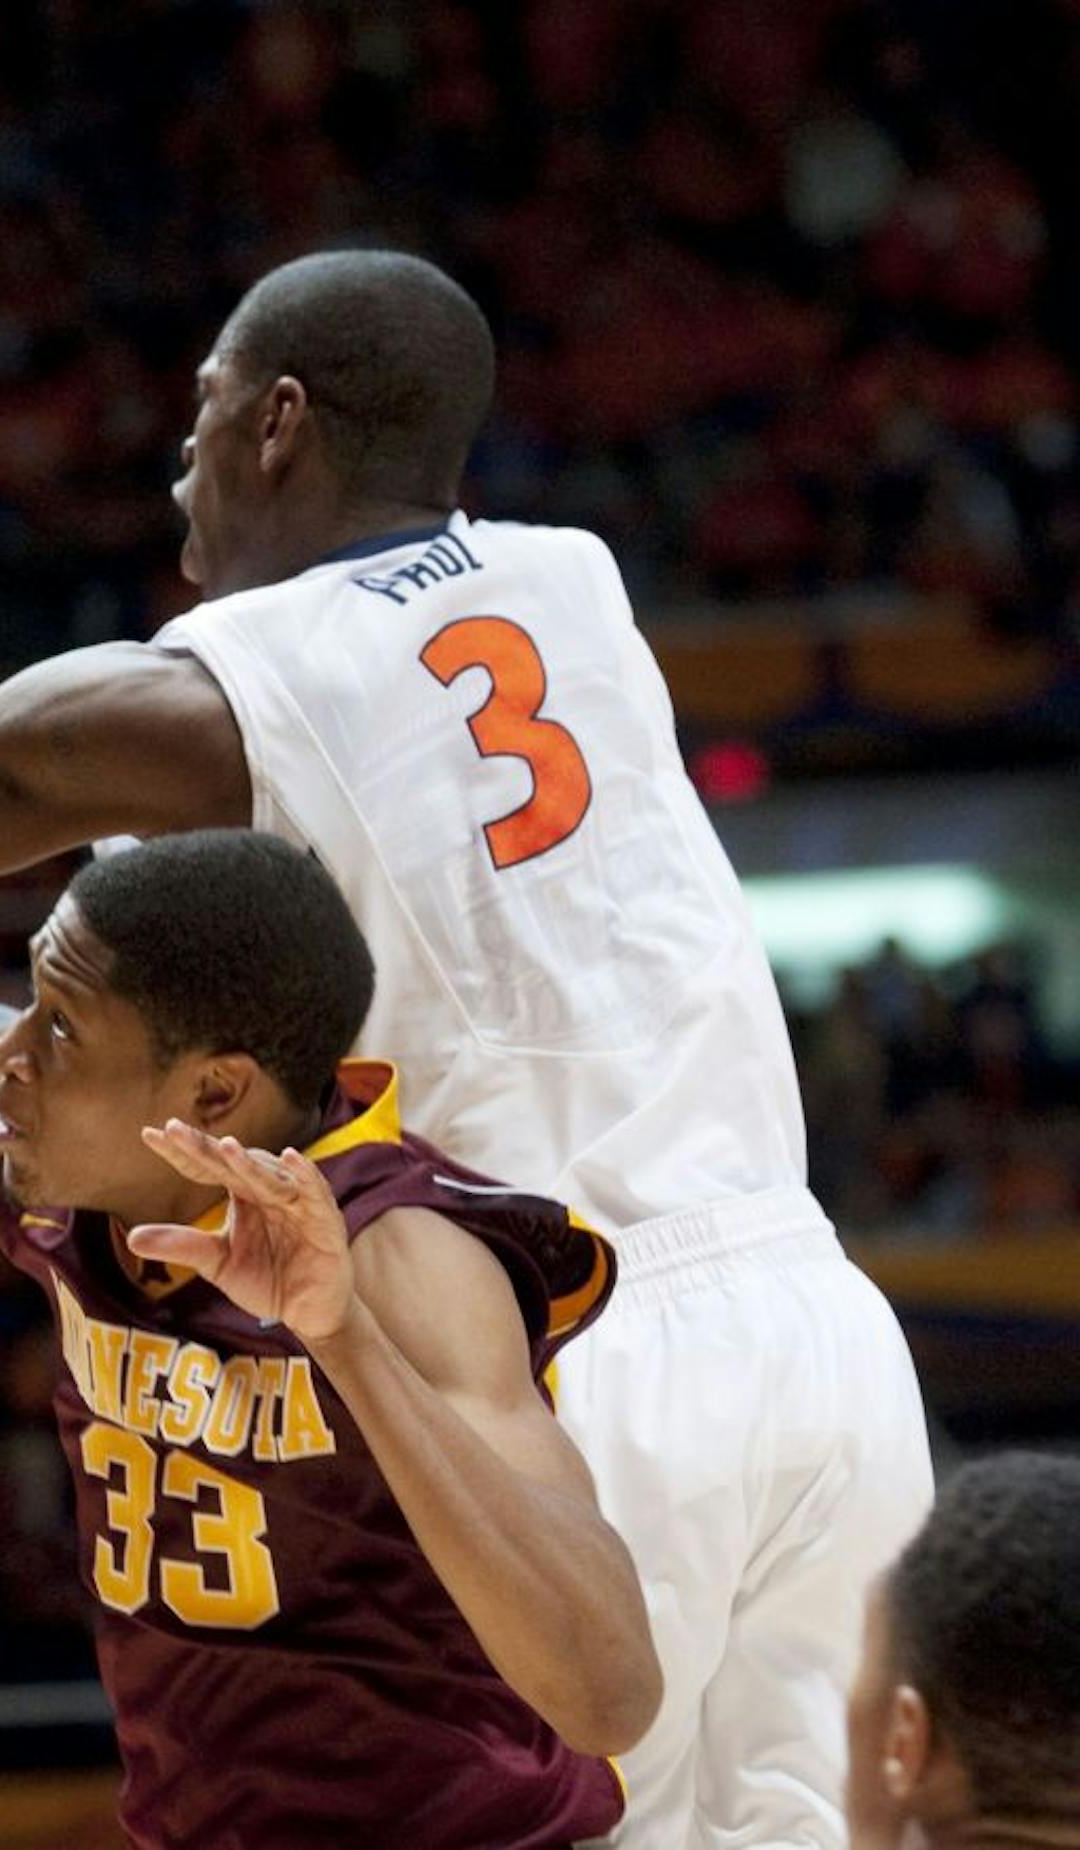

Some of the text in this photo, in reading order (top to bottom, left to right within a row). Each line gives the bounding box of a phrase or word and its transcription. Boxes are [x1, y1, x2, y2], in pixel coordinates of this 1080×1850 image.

[418, 615, 592, 871] 3
[51, 1266, 336, 1463] NESOTA
[80, 1421, 281, 1631] 33
